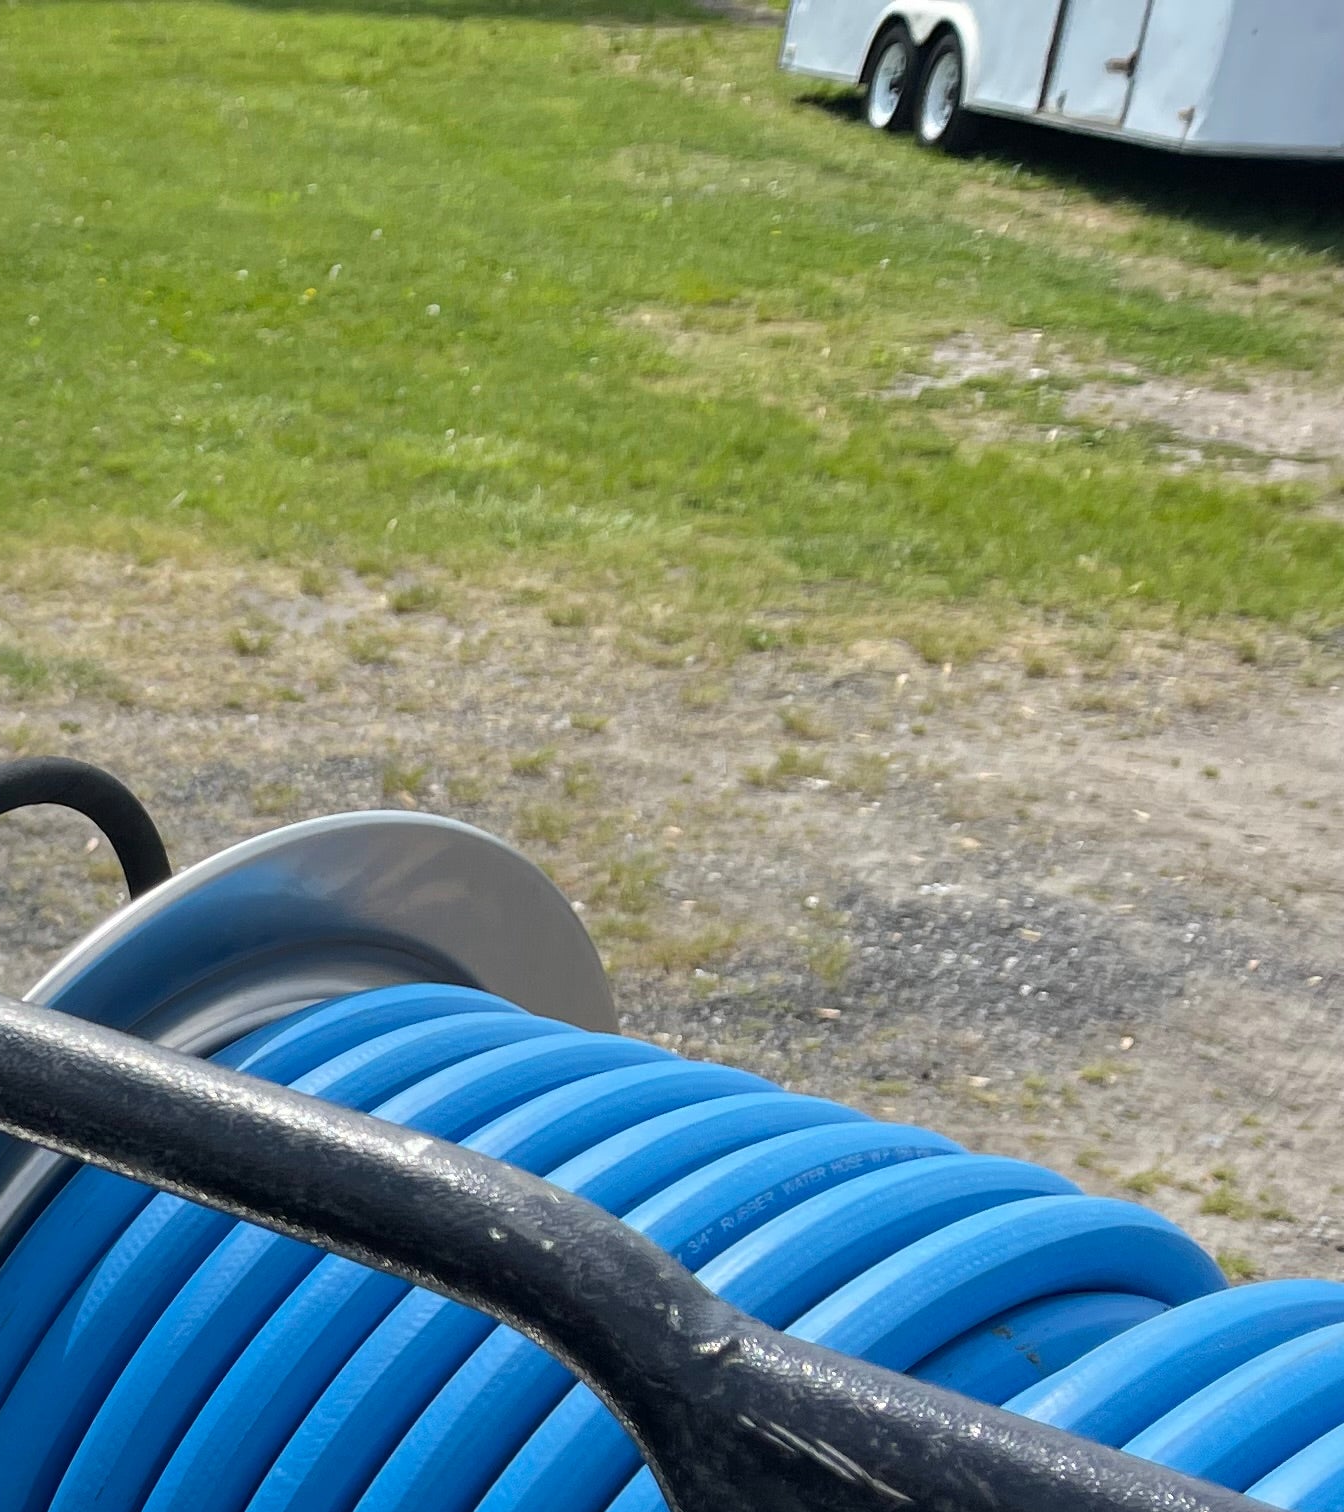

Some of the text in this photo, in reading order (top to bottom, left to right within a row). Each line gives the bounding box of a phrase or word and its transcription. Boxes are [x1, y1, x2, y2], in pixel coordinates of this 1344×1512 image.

[721, 1191, 775, 1232] RUBBER
[782, 1166, 827, 1195] WATER
[830, 1152, 865, 1175] HOSE
